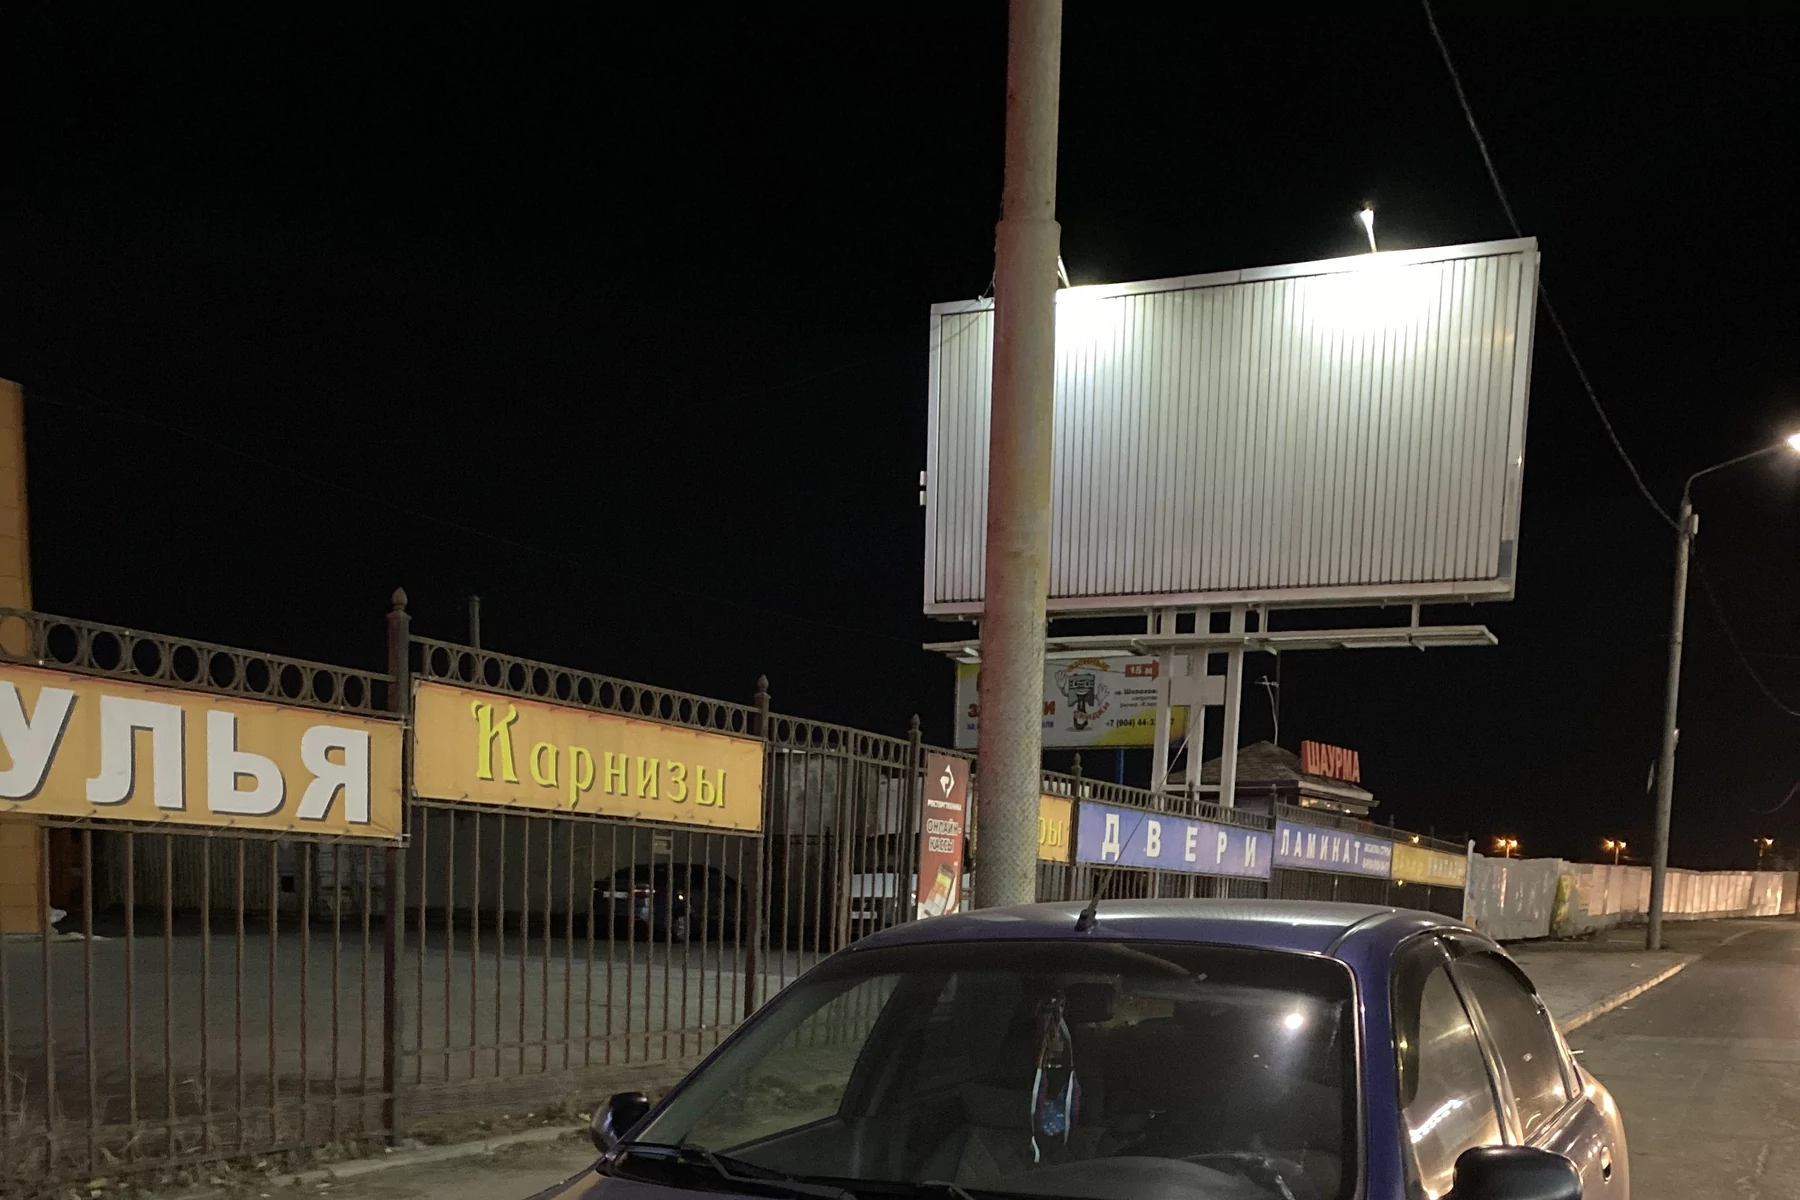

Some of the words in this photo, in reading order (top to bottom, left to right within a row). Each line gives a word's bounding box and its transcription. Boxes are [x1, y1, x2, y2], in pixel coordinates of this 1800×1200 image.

[0, 680, 374, 824] УЛЬЯ
[471, 700, 726, 809] Карнизы
[1304, 739, 1361, 783] ШАУРМА
[928, 836, 955, 853] КАССЫ
[1102, 813, 1257, 869] ДВЕРИ
[1280, 828, 1361, 865] ЛАМИНАТ
